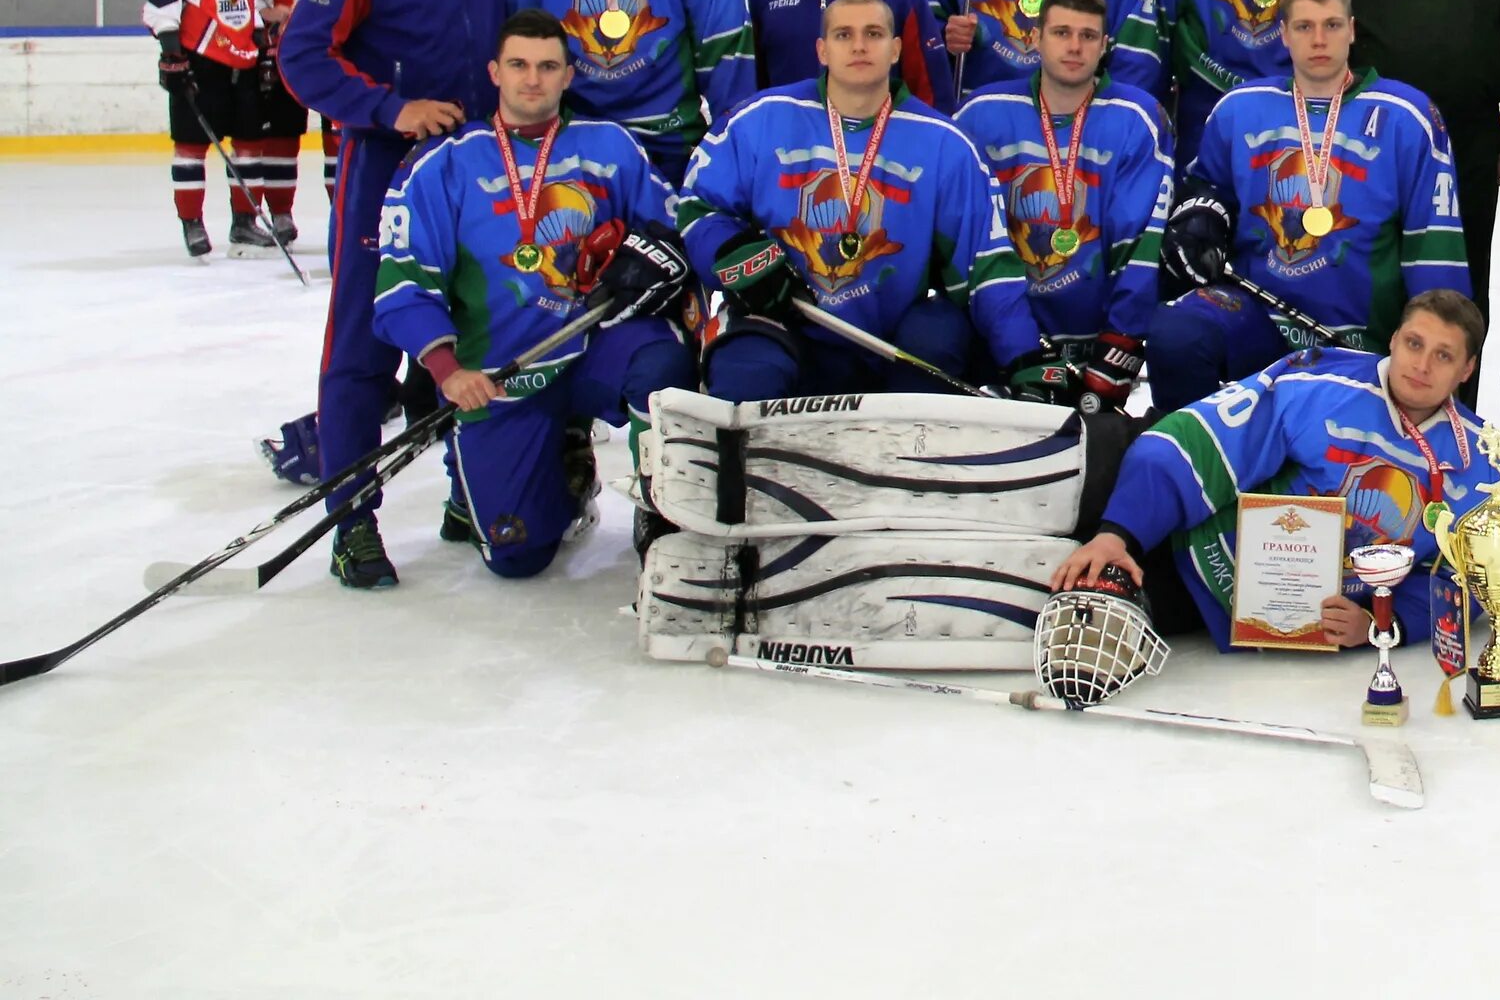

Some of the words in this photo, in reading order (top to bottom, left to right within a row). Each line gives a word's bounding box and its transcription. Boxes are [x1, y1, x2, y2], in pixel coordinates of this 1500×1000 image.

[992, 41, 1014, 60] ВДВ
[1016, 53, 1042, 66] РОСС
[598, 58, 646, 81] РОССИИ
[1277, 256, 1328, 277] РОССИИ
[1030, 269, 1081, 294] РОССИИ
[822, 283, 871, 307] РОССИИ
[1277, 325, 1321, 348] РОМЕ
[758, 394, 864, 418] VAUGHN
[1262, 541, 1318, 554] ГРАМОТА
[757, 641, 855, 666] VAUGHN
[775, 664, 809, 674] BAUER
